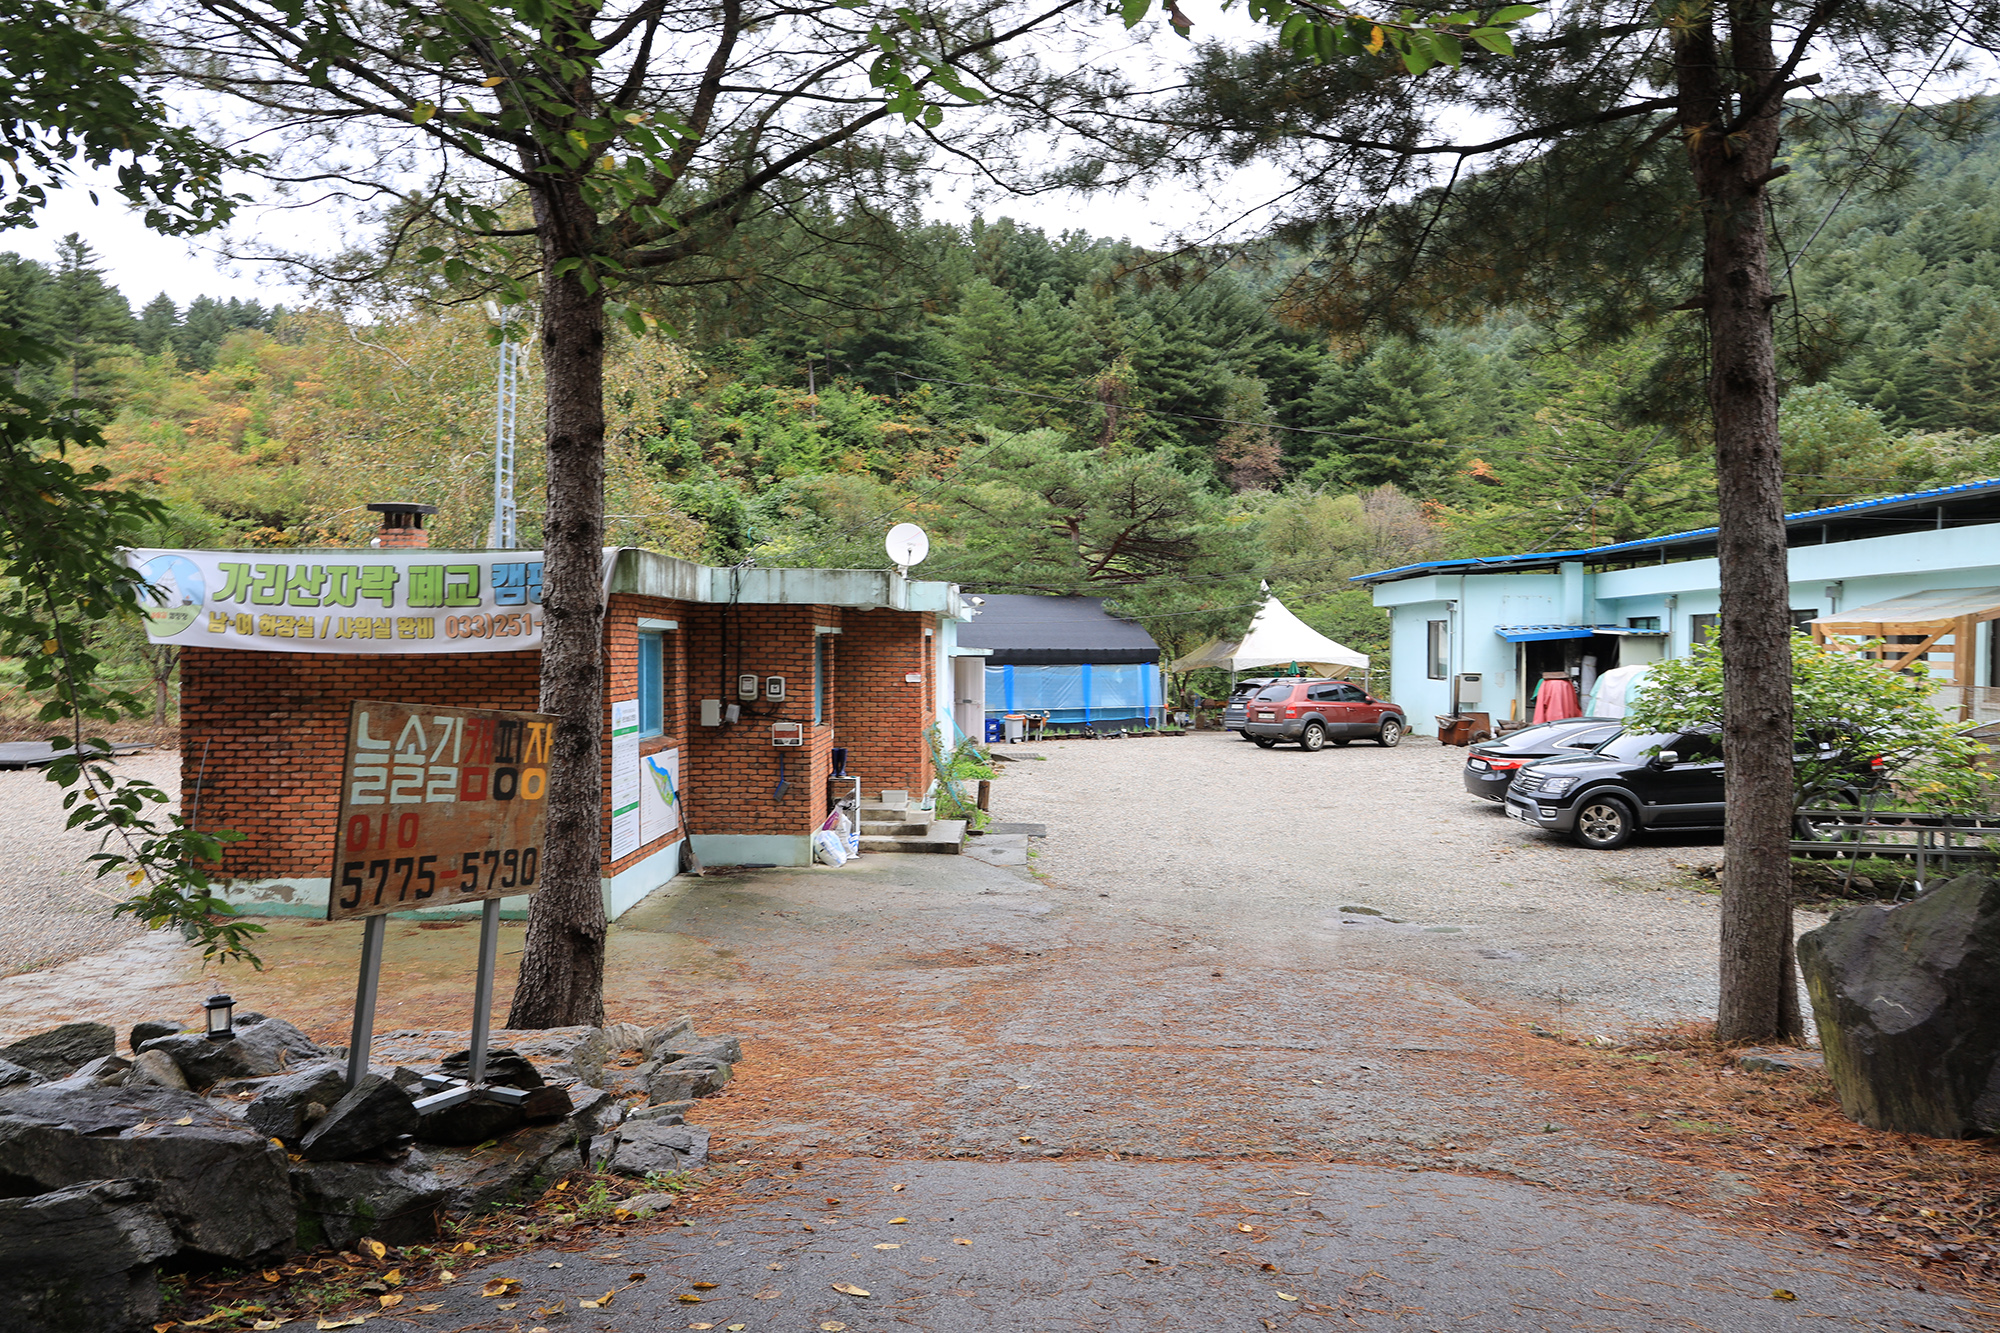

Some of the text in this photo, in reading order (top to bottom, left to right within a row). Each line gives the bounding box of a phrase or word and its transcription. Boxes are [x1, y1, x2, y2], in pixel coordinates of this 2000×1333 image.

[212, 561, 400, 608] 가리산자락
[407, 564, 483, 608] 폐교
[259, 614, 315, 639] 화장실
[335, 616, 392, 640] 샤워실
[396, 615, 435, 640] 완비
[346, 812, 420, 853] 010
[339, 847, 538, 909] 5775-5790
